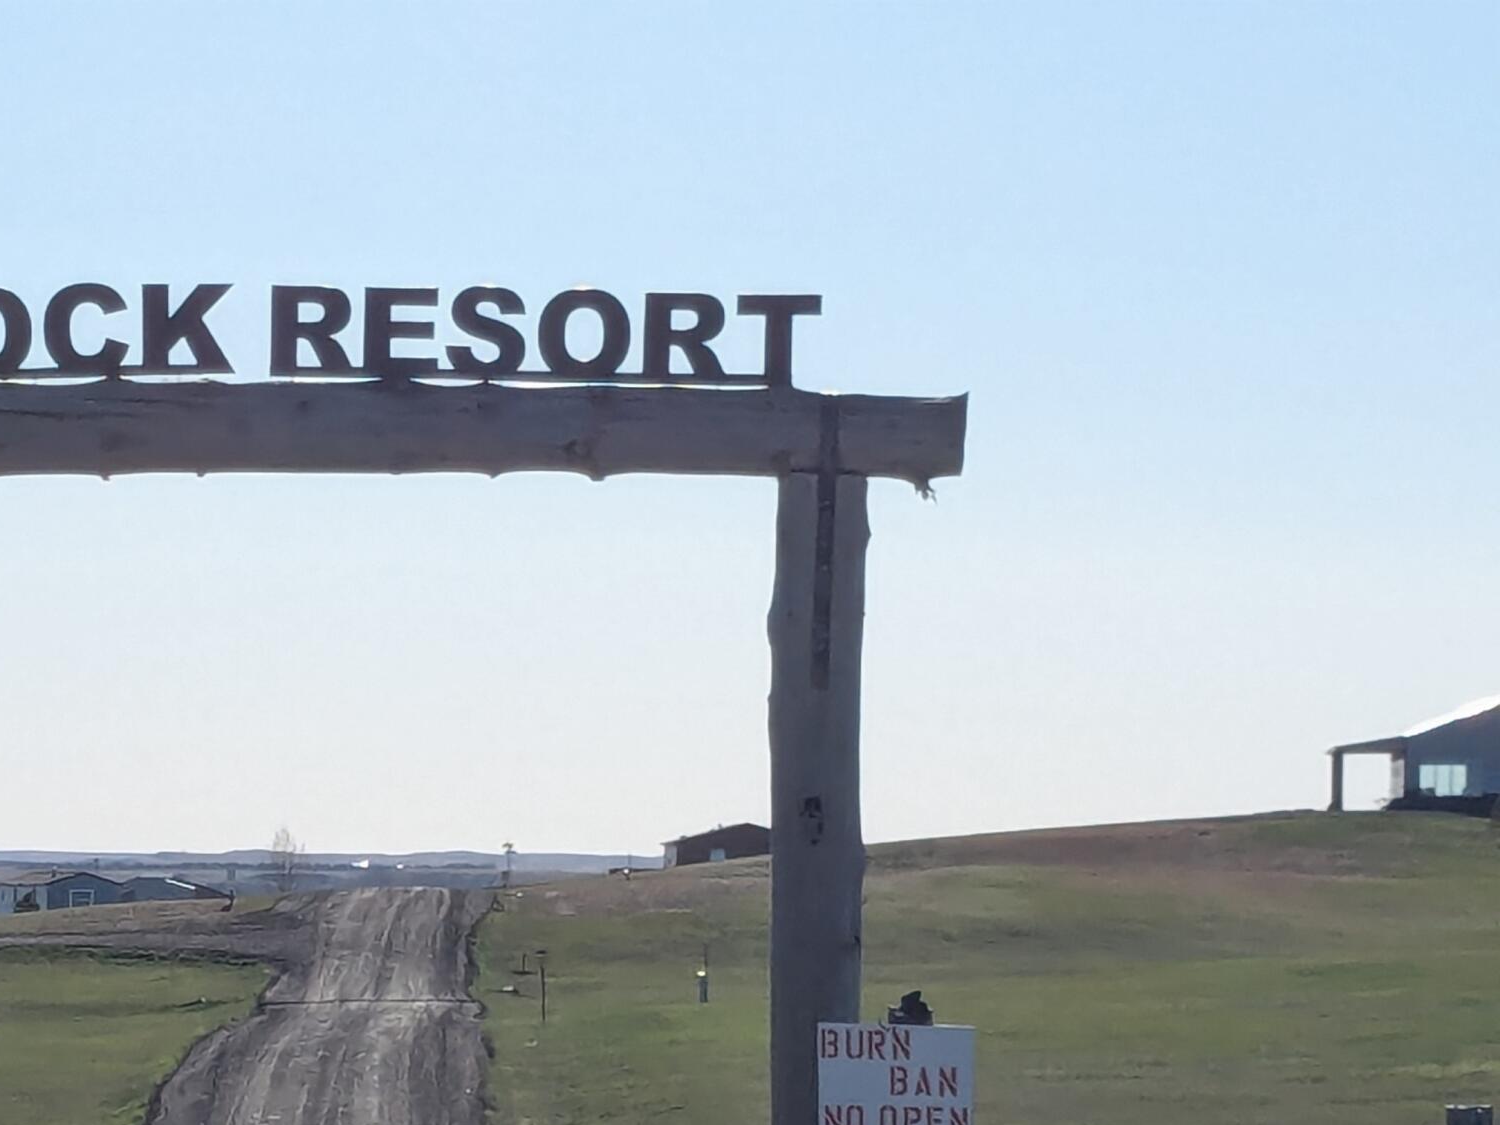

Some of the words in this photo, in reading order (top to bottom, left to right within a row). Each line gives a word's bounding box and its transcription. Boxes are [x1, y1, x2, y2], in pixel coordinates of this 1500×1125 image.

[270, 285, 823, 388] RESORT
[820, 1027, 912, 1061] BURN
[890, 1065, 958, 1098] BAN
